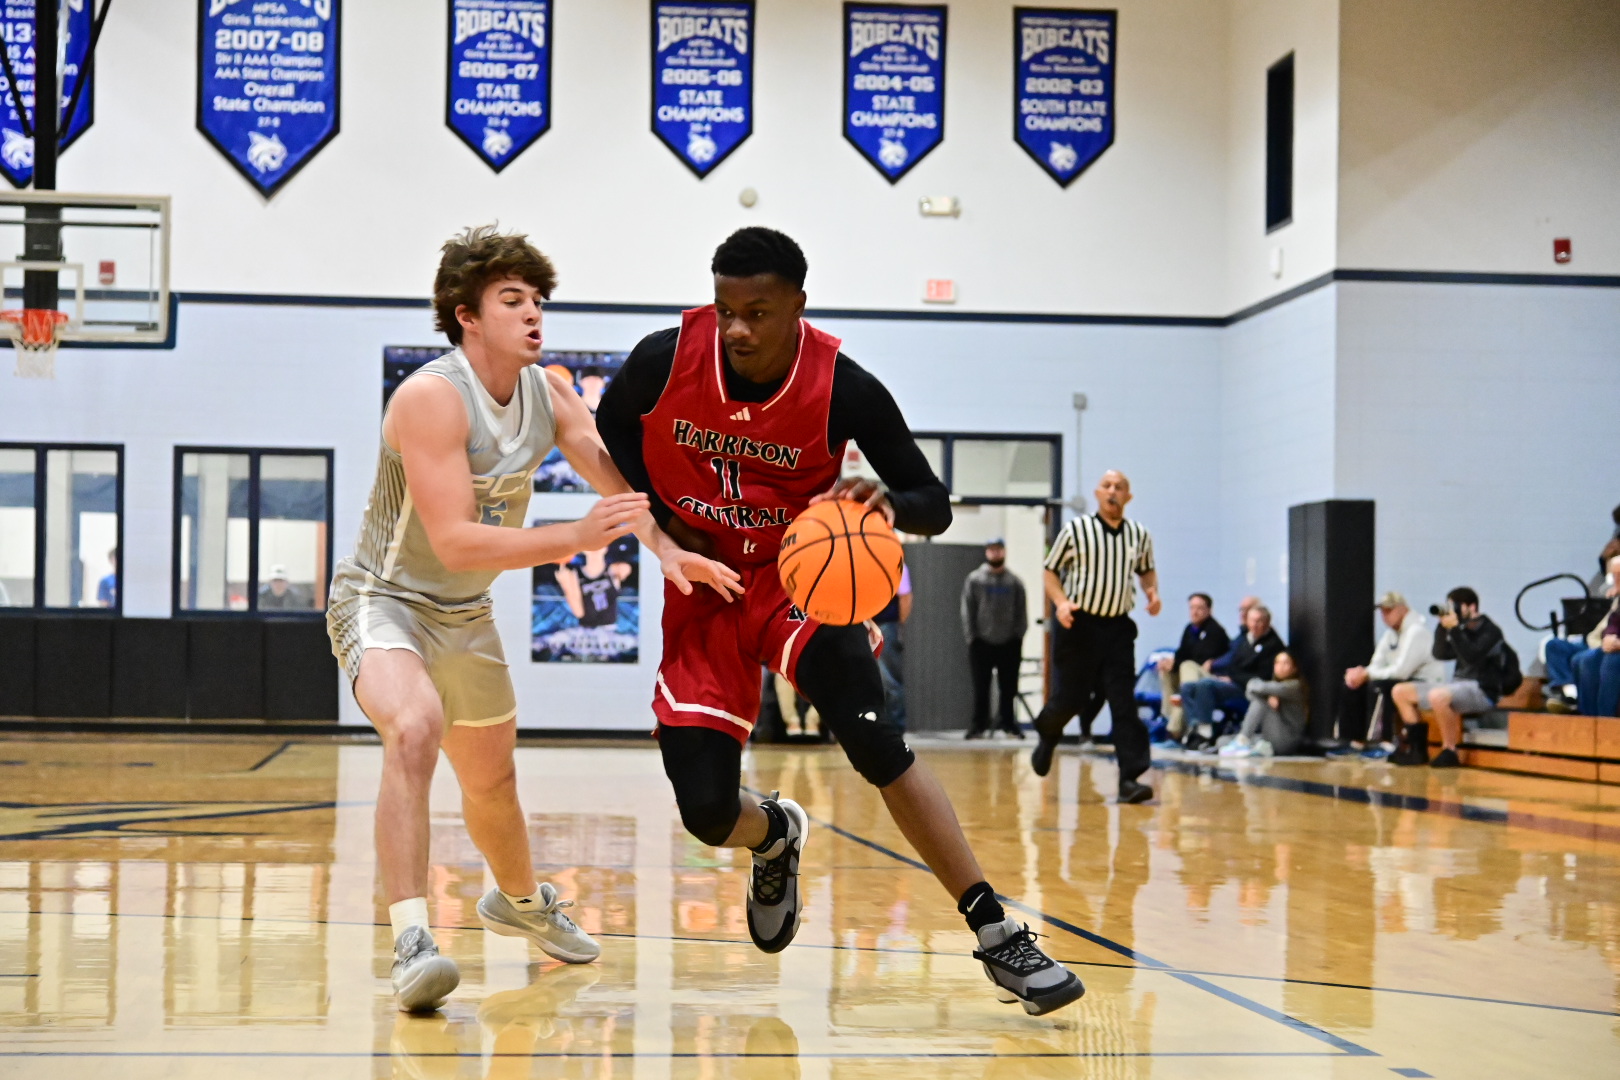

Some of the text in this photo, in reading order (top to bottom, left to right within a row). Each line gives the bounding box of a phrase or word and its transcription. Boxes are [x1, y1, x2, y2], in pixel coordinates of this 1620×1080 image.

[222, 13, 318, 28] Girls Basketball
[454, 9, 545, 48] BOBCATS
[215, 29, 324, 52] 2007-08
[658, 16, 748, 55] BOBCATS
[850, 22, 939, 61] BOBCATS
[1021, 27, 1109, 65] BOBCATS
[215, 52, 232, 65] Div
[243, 53, 269, 66] AAA
[270, 53, 323, 68] Champion
[214, 66, 325, 82] AAA State Champion
[459, 61, 539, 80] 2006-07
[243, 81, 295, 97] Overall
[476, 83, 520, 100] STATE
[854, 74, 935, 92] 2004-05
[213, 95, 325, 115] State Champion
[679, 89, 724, 106] STATE
[872, 94, 916, 111] STATE
[1021, 98, 1106, 116] SOUTH STATE
[454, 98, 542, 117] CHAMPIONS
[658, 105, 745, 123] CHAMPIONS
[850, 110, 937, 129] CHAMPIONS
[1025, 115, 1103, 133] CHAMPIONS
[673, 418, 801, 470] HARRISON
[710, 456, 742, 500] 11
[676, 496, 793, 529] CENTRAL
